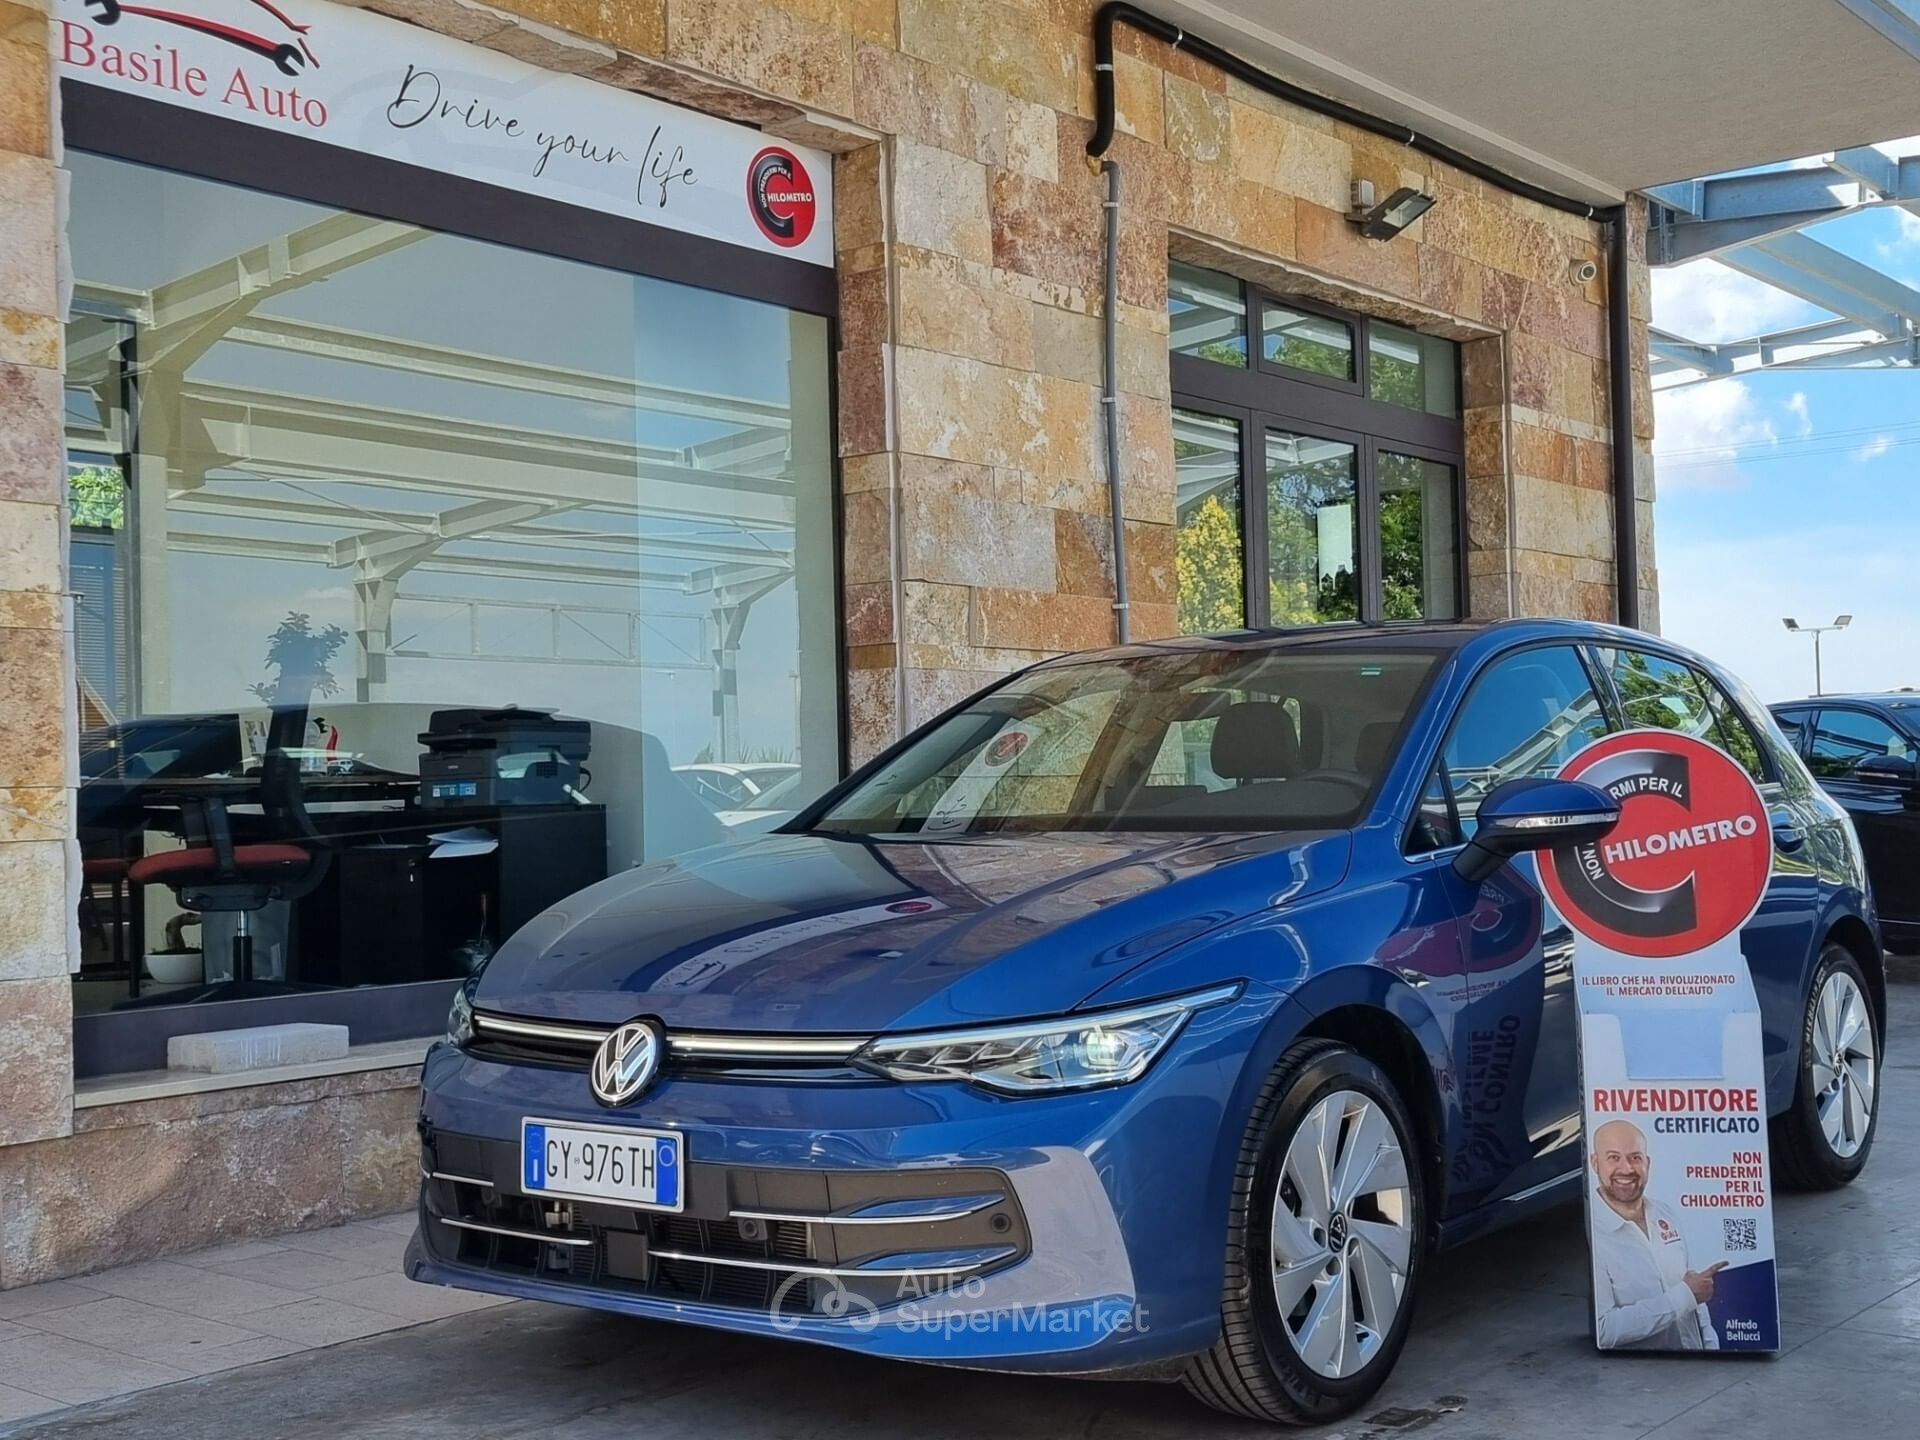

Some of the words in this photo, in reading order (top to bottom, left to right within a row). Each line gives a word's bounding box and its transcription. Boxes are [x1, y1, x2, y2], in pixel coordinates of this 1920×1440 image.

[57, 19, 208, 97] Basile
[220, 67, 328, 128] Auto
[387, 64, 525, 138] Drive
[536, 130, 630, 178] your
[637, 125, 699, 208] life
[1638, 777, 1669, 792] PER
[1671, 782, 1683, 798] IL
[1582, 849, 1605, 880] NON
[1582, 976, 1590, 985] IL
[1592, 976, 1619, 985] LIBRO
[1622, 976, 1640, 985] CHE
[1642, 976, 1655, 984] HA
[1660, 975, 1735, 985] RIVOLUZIONATO
[1606, 987, 1614, 996] IL
[1619, 986, 1663, 996] MERCATO
[1665, 985, 1713, 995] DELL'AUTO
[1594, 1088, 1759, 1112] RIVENDITORE
[1654, 1117, 1760, 1134] CERTIFICATO
[1733, 1152, 1762, 1164] NON
[1686, 1166, 1763, 1178] PRENDERMI
[1726, 1181, 1750, 1193] PER
[1753, 1181, 1765, 1193] IL
[1680, 1195, 1765, 1207] CHILOMETRO
[1726, 1319, 1758, 1330] Alfredo
[1726, 1331, 1761, 1342] Bellucci
